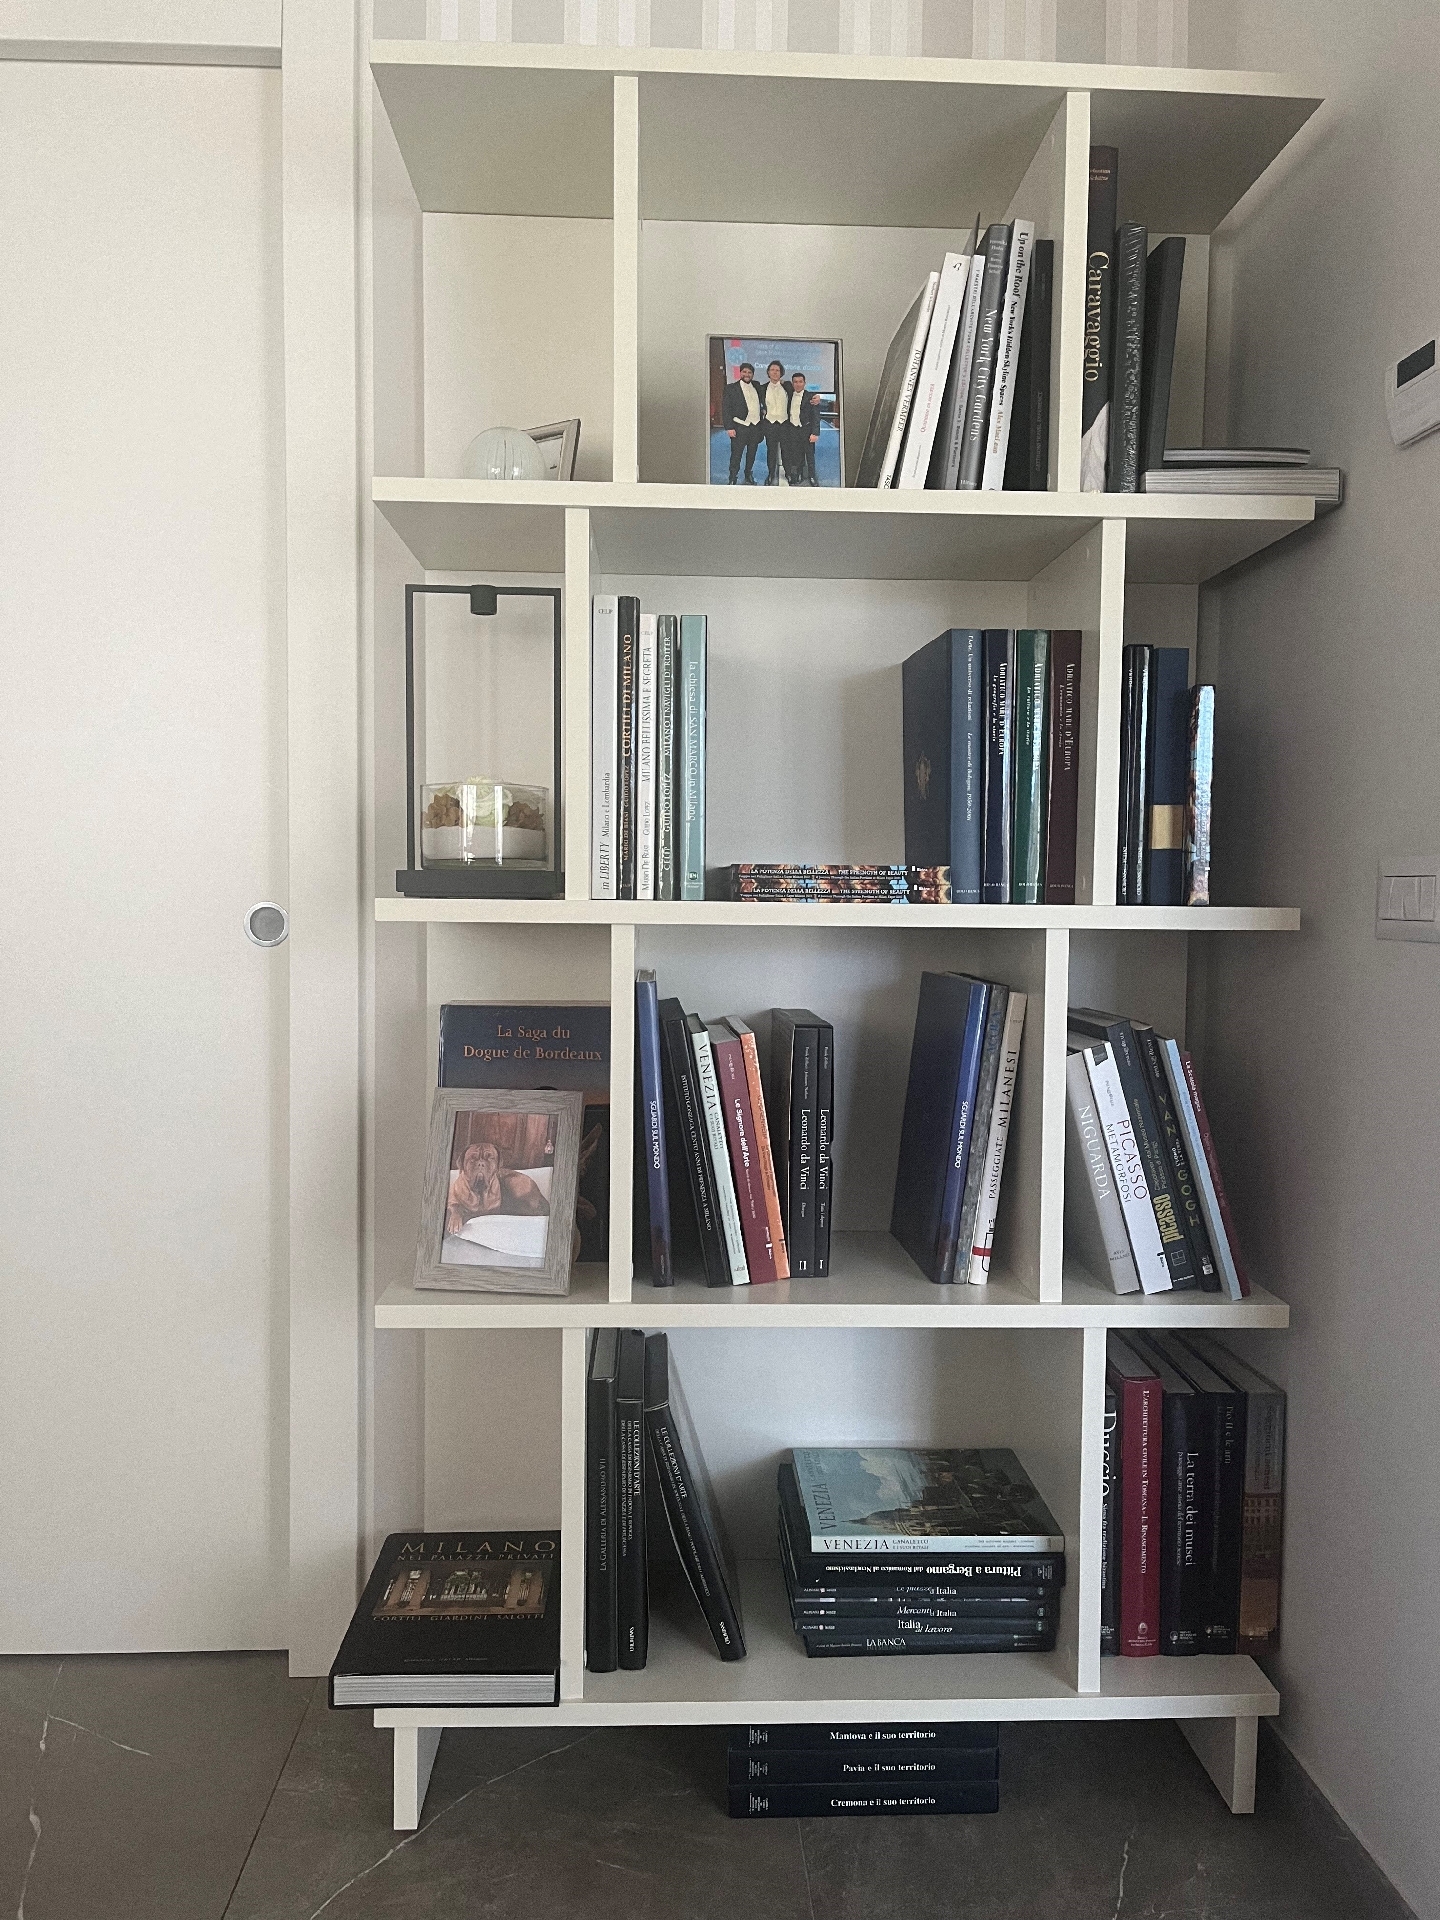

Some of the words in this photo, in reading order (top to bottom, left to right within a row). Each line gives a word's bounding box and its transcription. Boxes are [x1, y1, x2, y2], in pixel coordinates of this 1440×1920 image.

[1017, 231, 1028, 244] Up
[1017, 245, 1025, 258] on
[1014, 258, 1025, 274] the
[1011, 275, 1023, 298] Roof
[1009, 300, 1018, 314] New
[1085, 251, 1110, 382] Caravaggio
[982, 307, 997, 334] New
[976, 336, 993, 363] York
[905, 349, 922, 392] JOHANNES
[972, 365, 989, 390] City
[999, 359, 1010, 382] Skyline
[996, 383, 1006, 405] Spaces
[896, 393, 911, 432] VERMEER
[969, 393, 986, 442] Gardens
[622, 633, 632, 685] MILANO
[642, 645, 651, 684] SEGRETA
[689, 662, 697, 670] la
[622, 689, 631, 702] DI
[663, 679, 671, 710] NAVIGLI
[689, 673, 697, 702] chiesa
[689, 706, 697, 714] di
[621, 706, 631, 756] CORTILI
[663, 719, 671, 755] MILANO
[641, 745, 650, 782] MILANO
[602, 771, 610, 806] Lombardia
[689, 778, 696, 786] in
[599, 841, 610, 878] LIBERTY
[600, 881, 609, 889] in
[497, 1025, 512, 1037] La
[518, 1026, 547, 1041] Saga
[552, 1026, 570, 1039] du
[463, 1045, 509, 1061] Dogue
[513, 1046, 530, 1059] de
[535, 1047, 602, 1061] Bordeaux
[1185, 1060, 1192, 1068] La
[697, 1043, 717, 1110] VENEZIA
[1187, 1068, 1197, 1090] Scatola
[734, 1098, 741, 1107] Le
[1192, 1091, 1202, 1112] magica
[648, 1100, 659, 1129] SGUARDI
[734, 1108, 745, 1136] Signore
[958, 1100, 969, 1129] SGUARDI
[989, 1136, 1004, 1199] PASSEGGIATE
[997, 1050, 1017, 1127] MILANESI
[1158, 1093, 1177, 1137] VAN
[650, 1129, 658, 1141] SUL
[800, 1108, 810, 1151] Leonardo
[819, 1108, 828, 1150] Leonardo
[957, 1129, 965, 1140] SUL
[1139, 1126, 1150, 1148] Museo
[650, 1141, 661, 1169] MONDO
[740, 1137, 750, 1167] dell'Arte
[800, 1153, 809, 1164] da
[819, 1153, 828, 1164] da
[953, 1141, 963, 1168] MONDO
[1078, 1105, 1111, 1200] NIGUARDA
[1105, 1123, 1130, 1204] METAMORFOSI
[1117, 1119, 1148, 1200] PICASSO
[799, 1166, 809, 1190] Vinci
[819, 1166, 828, 1189] Vinci
[1177, 1169, 1201, 1227] GOGH
[659, 1426, 668, 1436] LE
[632, 1430, 640, 1471] COLLEZIONI
[1225, 1439, 1233, 1447] le
[1186, 1452, 1198, 1468] La
[1186, 1472, 1196, 1502] terra
[813, 1483, 836, 1530] VENEZIA
[1186, 1505, 1197, 1525] dei
[401, 1540, 556, 1553] MILANO
[823, 1538, 889, 1550] VENEZIA
[1185, 1529, 1197, 1566] musei
[925, 1563, 972, 1576] Bergamo
[983, 1566, 1021, 1576] Pittura
[896, 1619, 921, 1630] Italia
[866, 1638, 876, 1646] LA
[877, 1637, 906, 1646] BANCA
[830, 1731, 867, 1741] Mantova
[898, 1730, 936, 1739] territorio
[843, 1763, 865, 1772] Pavia
[898, 1762, 936, 1771] territorio
[830, 1798, 868, 1807] Cremona
[899, 1796, 936, 1806] territorio
